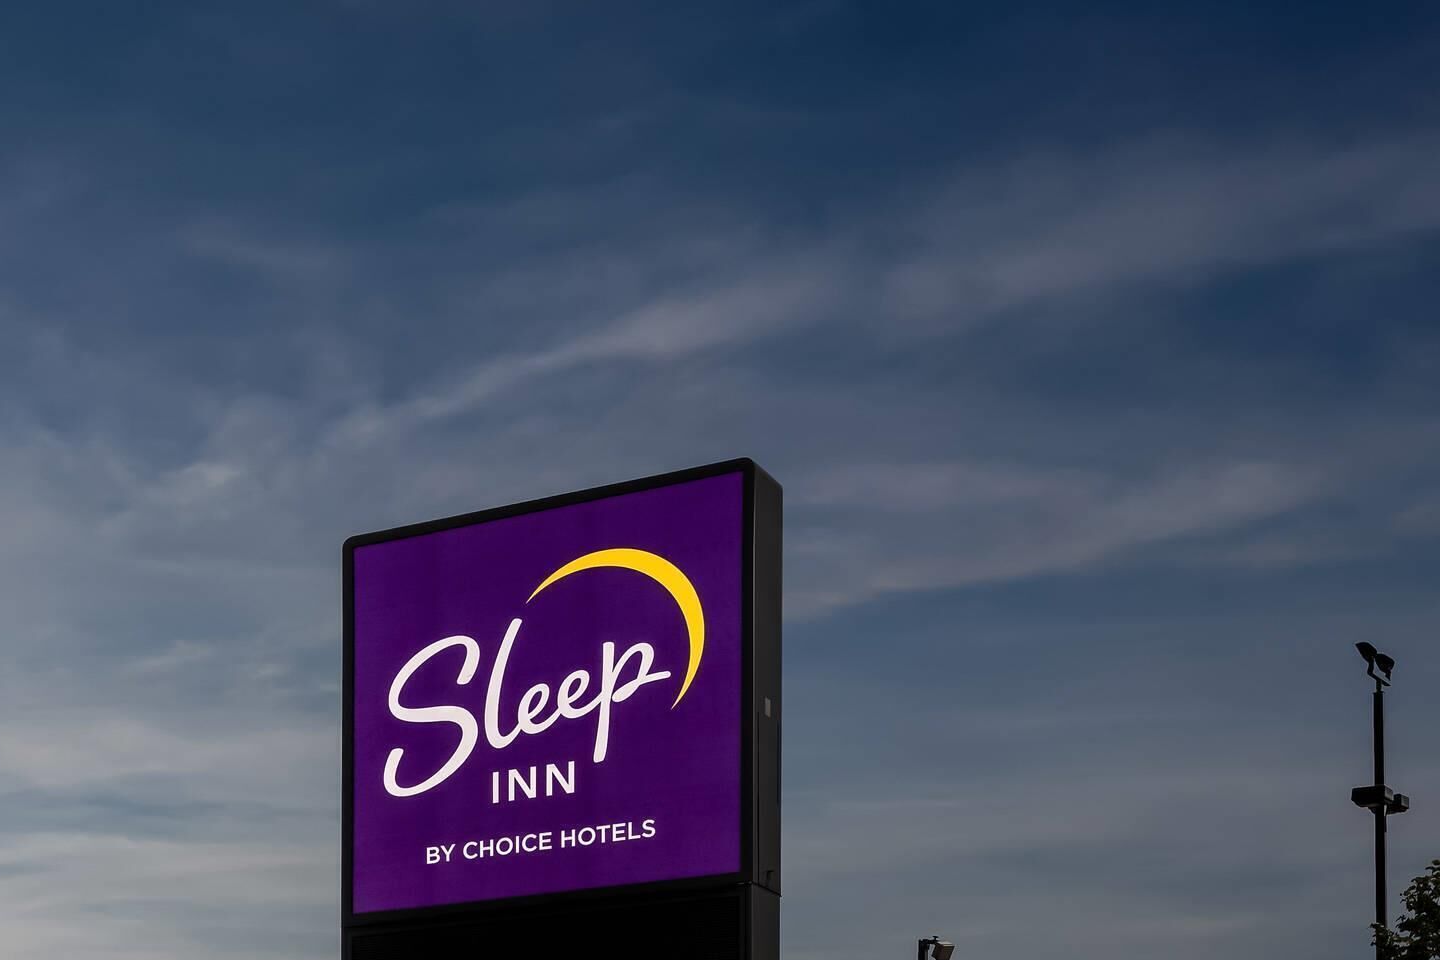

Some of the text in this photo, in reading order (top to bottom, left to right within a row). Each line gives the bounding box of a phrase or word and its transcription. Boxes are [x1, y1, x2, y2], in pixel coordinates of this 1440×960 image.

[384, 618, 671, 797] Sleep
[492, 761, 575, 803] INN
[426, 819, 656, 865] BY CHOICE HOTELS
